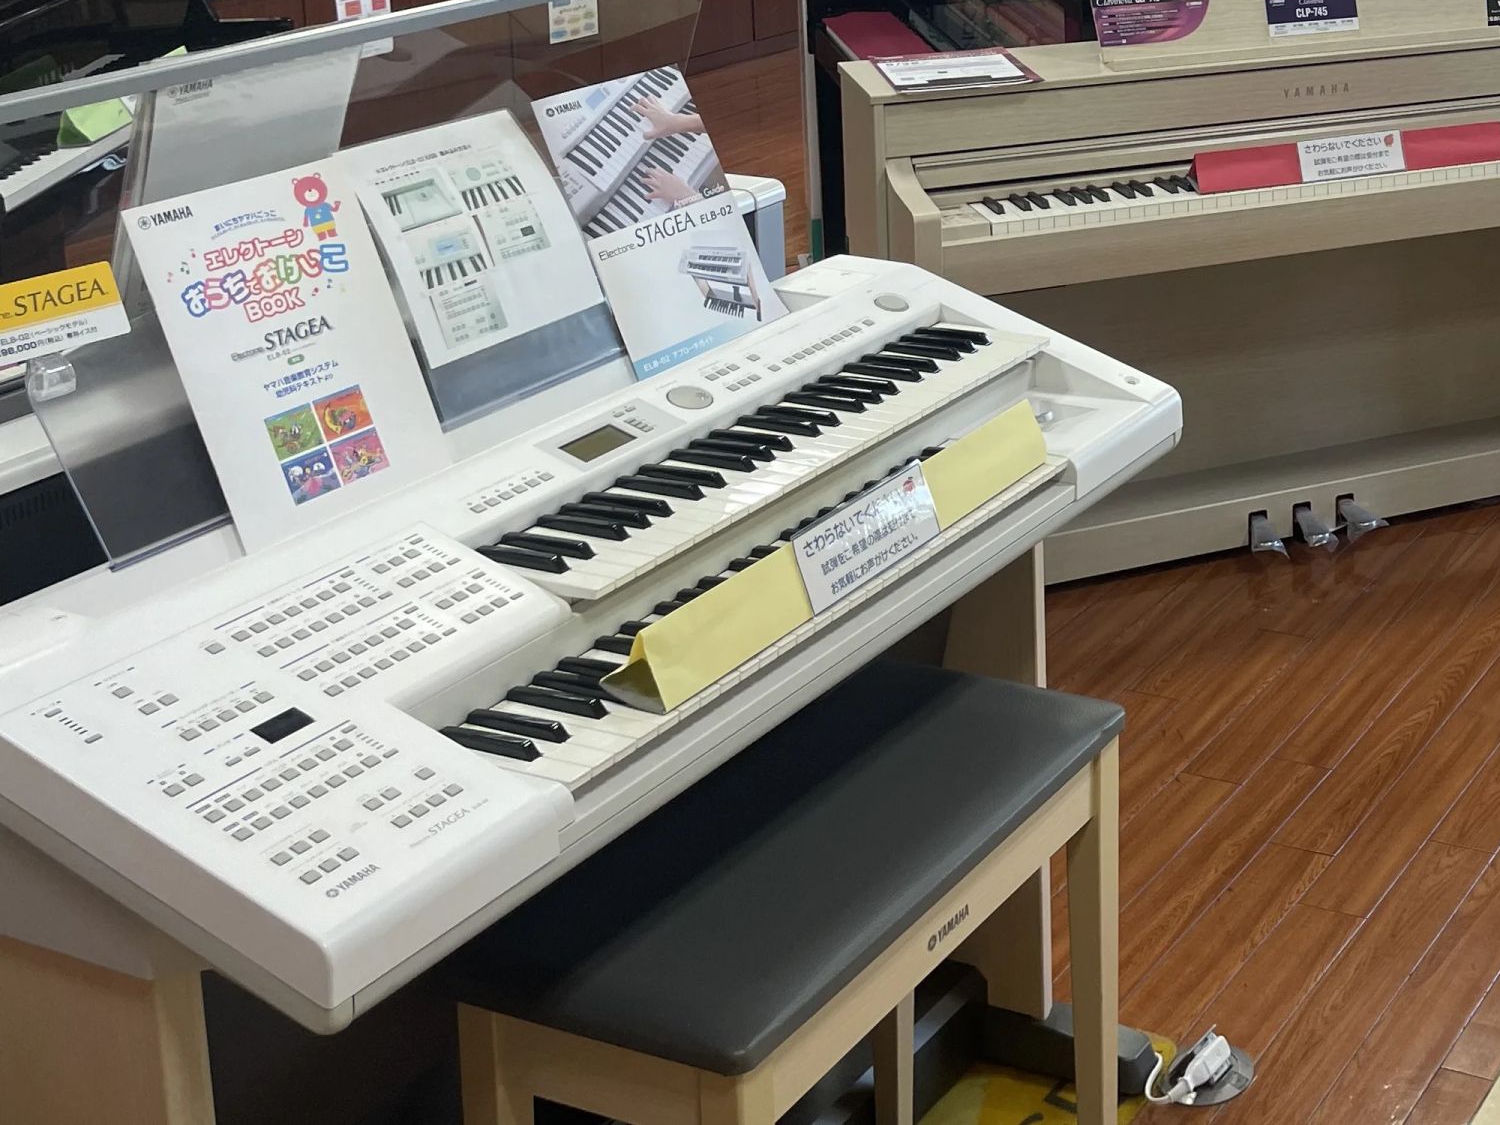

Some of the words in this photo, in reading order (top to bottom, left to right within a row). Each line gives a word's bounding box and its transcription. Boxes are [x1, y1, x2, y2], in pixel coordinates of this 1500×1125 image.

[1296, 6, 1328, 19] CLP-745
[178, 78, 214, 96] YAMAHA
[1283, 82, 1350, 98] YAMAHA
[554, 100, 583, 115] YAMAHA
[1304, 136, 1382, 154] さわらないでください
[702, 183, 726, 200] Guide
[150, 204, 194, 227] YAMAHA
[598, 242, 637, 262] Electone
[634, 211, 696, 249] STAGEA
[699, 203, 734, 225] ELB-02
[203, 228, 304, 272] エレクトーン
[181, 243, 350, 318] おうちでおけいこ
[13, 277, 106, 318] STAGEA
[243, 286, 306, 323] BOOK
[264, 314, 334, 351] STAGEA
[830, 532, 919, 595] お気軽にお声がけください。
[428, 807, 471, 837] STAGEA
[336, 863, 381, 891] YAMAHA
[937, 903, 969, 943] YAMAHA
